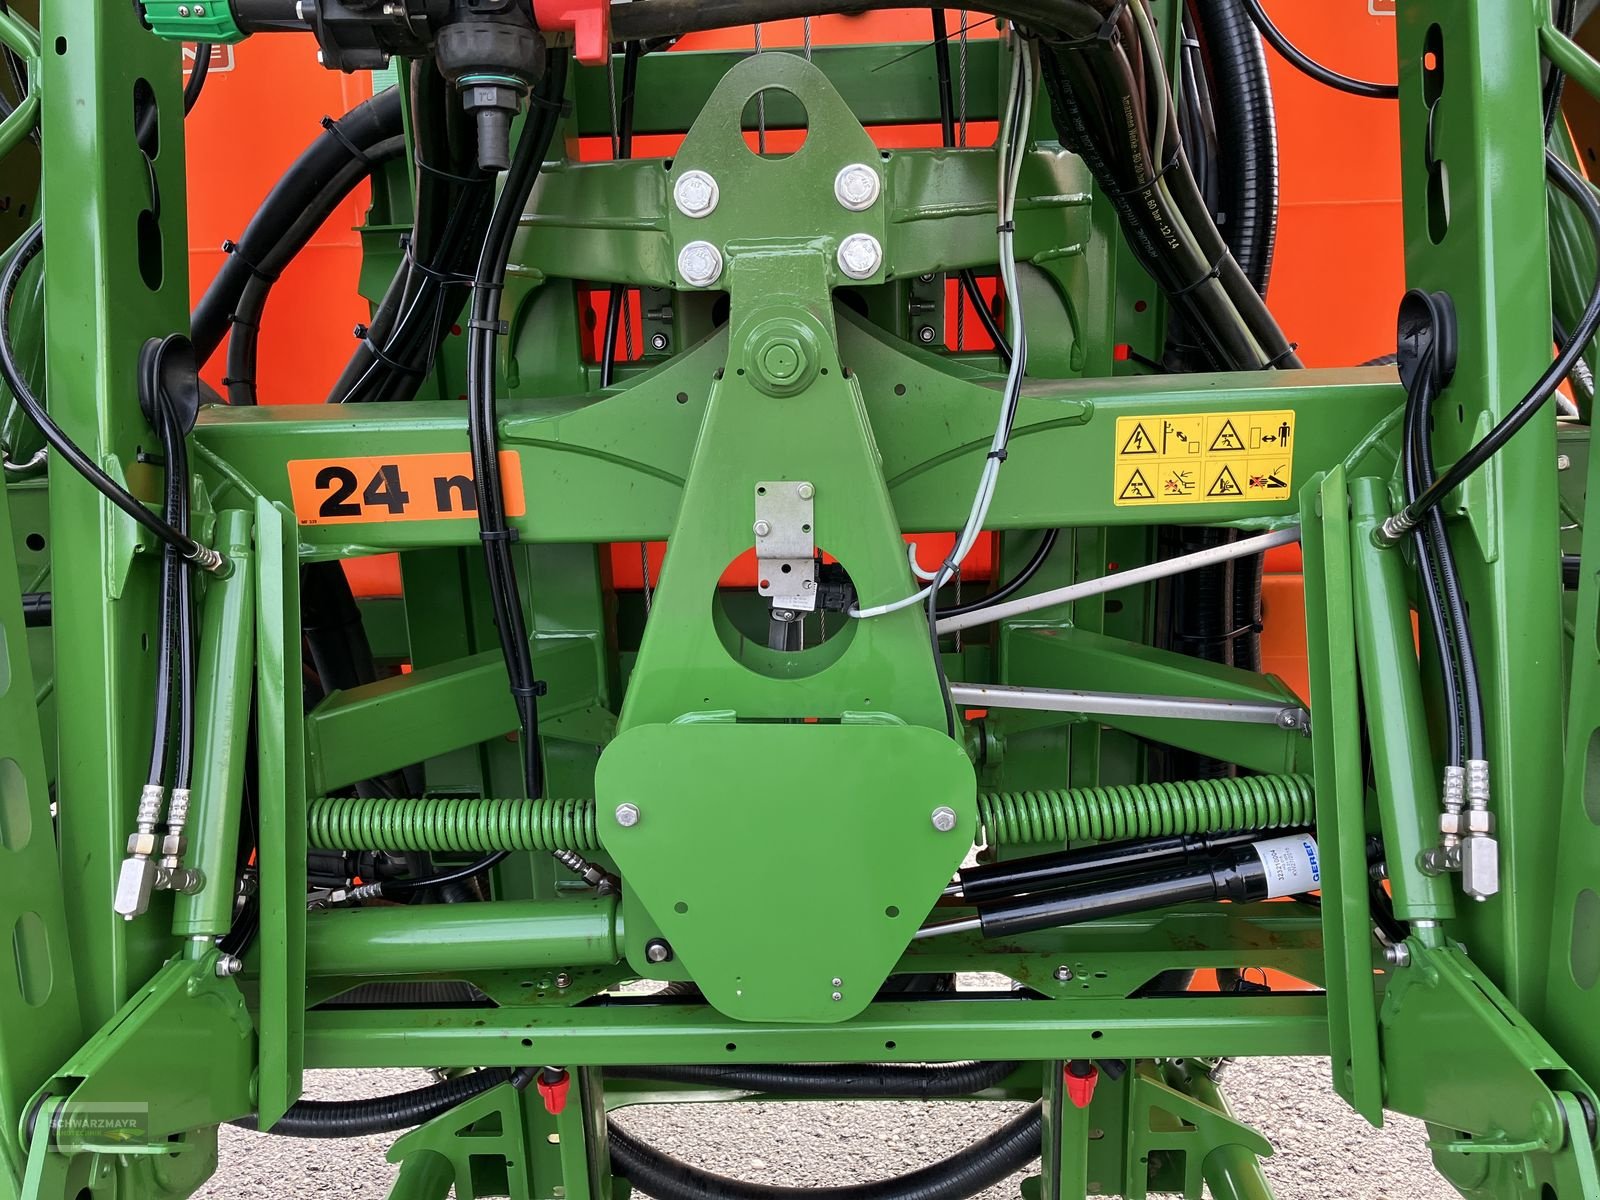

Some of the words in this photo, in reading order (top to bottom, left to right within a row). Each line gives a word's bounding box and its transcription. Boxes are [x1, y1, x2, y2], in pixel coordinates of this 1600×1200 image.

[1121, 95, 1134, 128] Amazonen
[1142, 189, 1151, 200] PL
[1147, 200, 1157, 210] 60
[1151, 209, 1162, 222] bar
[315, 464, 410, 518] 24
